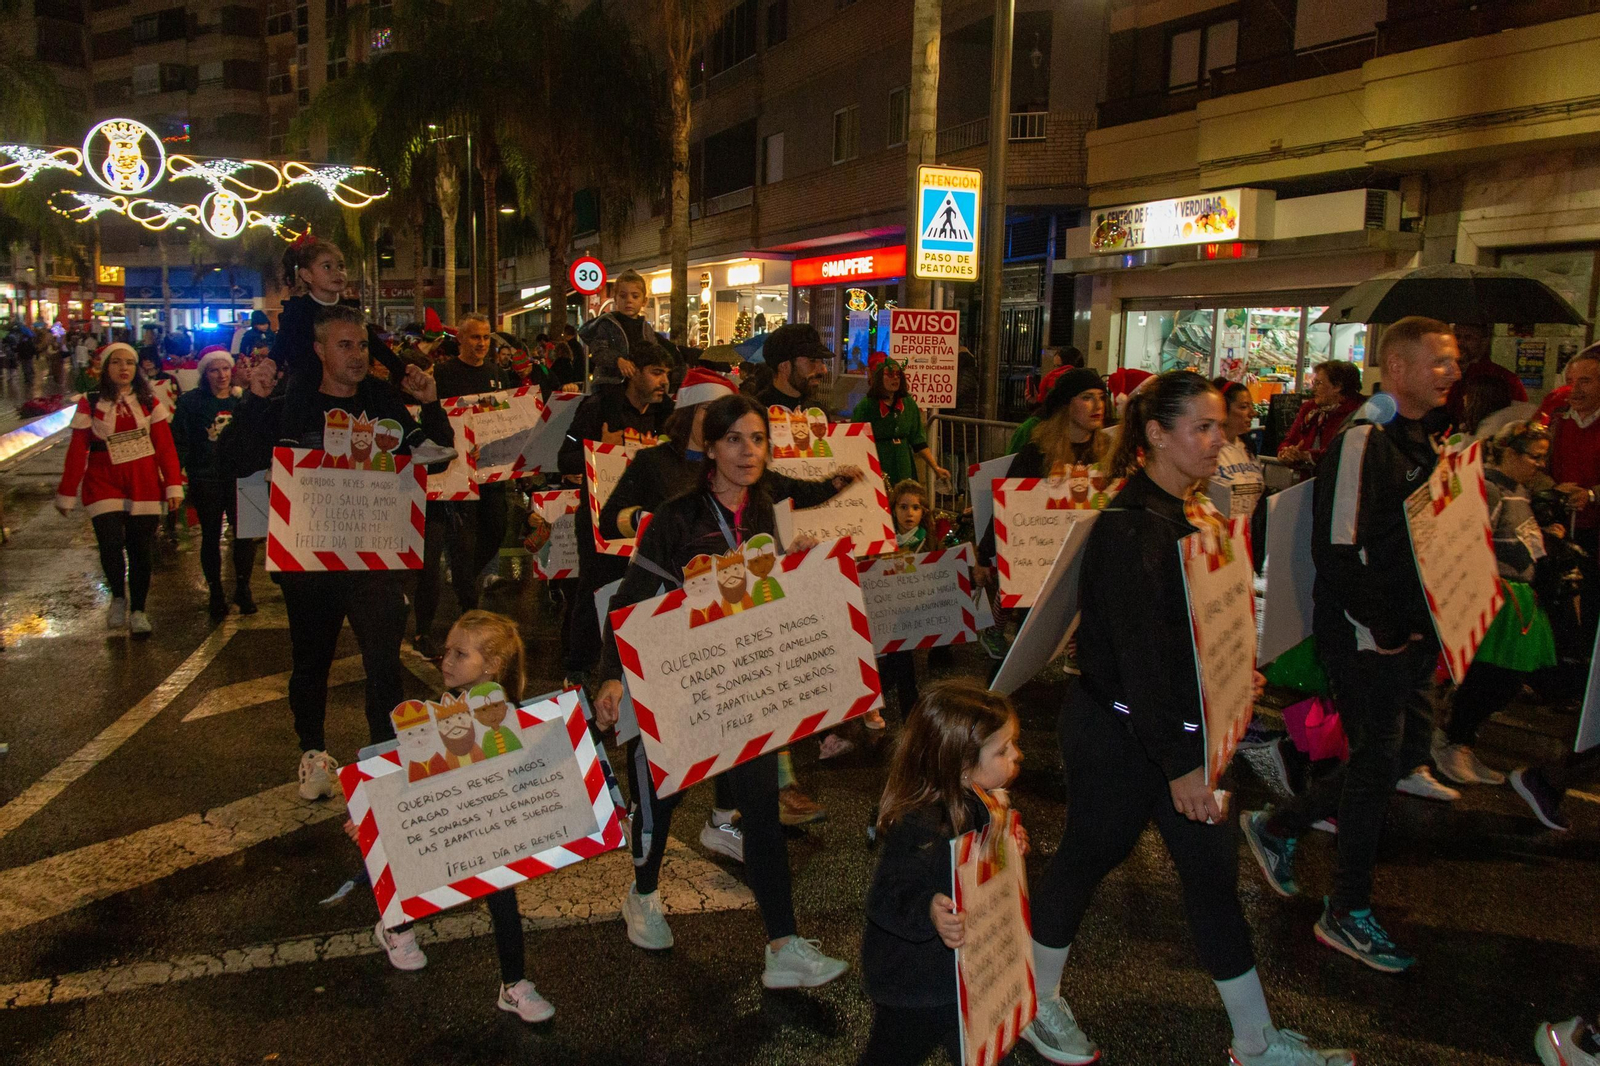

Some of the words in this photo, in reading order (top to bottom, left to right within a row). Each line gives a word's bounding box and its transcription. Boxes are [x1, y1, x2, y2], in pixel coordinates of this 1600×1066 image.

[923, 174, 977, 188] ATENCIÓN
[1134, 208, 1144, 224] DE
[1174, 202, 1180, 218] Y
[1180, 196, 1222, 218] VERDURAS
[924, 252, 952, 262] PASO
[957, 254, 970, 264] DE
[828, 256, 874, 277] MAPFRE
[920, 264, 973, 274] PEATONES
[579, 269, 598, 282] 30
[894, 314, 956, 332] AVISO
[902, 336, 946, 346] PRUEBA
[894, 344, 954, 355] DEPORTIVA
[905, 372, 950, 384] RÁFICO
[928, 394, 952, 404] 21:00
[300, 476, 336, 487] QUERIDOS
[342, 478, 364, 489] REYES
[302, 492, 331, 505] PIDO
[374, 497, 397, 507] AMOR
[311, 507, 318, 518] Y
[326, 508, 365, 520] LLEGAR
[372, 509, 388, 521] SIN
[1012, 512, 1059, 527] QUERIDOS
[308, 520, 382, 533] LESIONARME
[296, 533, 326, 548] ¡FELIZ
[355, 536, 364, 548] DE
[372, 536, 404, 550] REYES!
[1013, 557, 1032, 568] PARA
[862, 578, 890, 590] RIDOS
[874, 594, 892, 604] QUE
[897, 590, 915, 600] CREE
[918, 590, 926, 598] EN
[914, 620, 922, 629] DE
[660, 643, 726, 676] QUERIDOS
[735, 627, 774, 648] REYES
[779, 614, 825, 634] MAGOS:
[680, 664, 726, 690] CARGAD
[732, 646, 774, 668] VUESTROS
[779, 630, 828, 653] CAMELLOS
[692, 691, 711, 705] DE
[717, 667, 772, 695] SONRISAS
[775, 662, 781, 674] Y
[786, 645, 836, 670] LLENADNOS
[690, 710, 711, 726] LAS
[716, 685, 775, 716] ZAPATILLAS
[778, 681, 788, 692] DE
[720, 712, 754, 738] ¡FELIZ
[762, 703, 779, 717] DÍA
[782, 698, 795, 708] DE
[799, 682, 832, 701] REYES!
[397, 785, 463, 813] QUERIDOS
[467, 772, 504, 790] REYES
[507, 758, 550, 776] MAGOS:
[401, 807, 449, 829] CARGAD
[456, 788, 508, 811] VUESTROS
[512, 771, 564, 793] CAMELLOS
[406, 832, 422, 845] DE
[430, 817, 481, 837] SONRISAS
[487, 808, 493, 819] Y
[500, 788, 560, 813] LLENADNOS
[418, 843, 438, 856] LAS
[444, 824, 500, 848] ZAPATILLAS
[504, 815, 518, 827] DE
[446, 855, 486, 877] ¡FELIZ
[492, 848, 510, 859] DÍA
[514, 841, 527, 853] DE
[531, 825, 568, 847] REYES!
